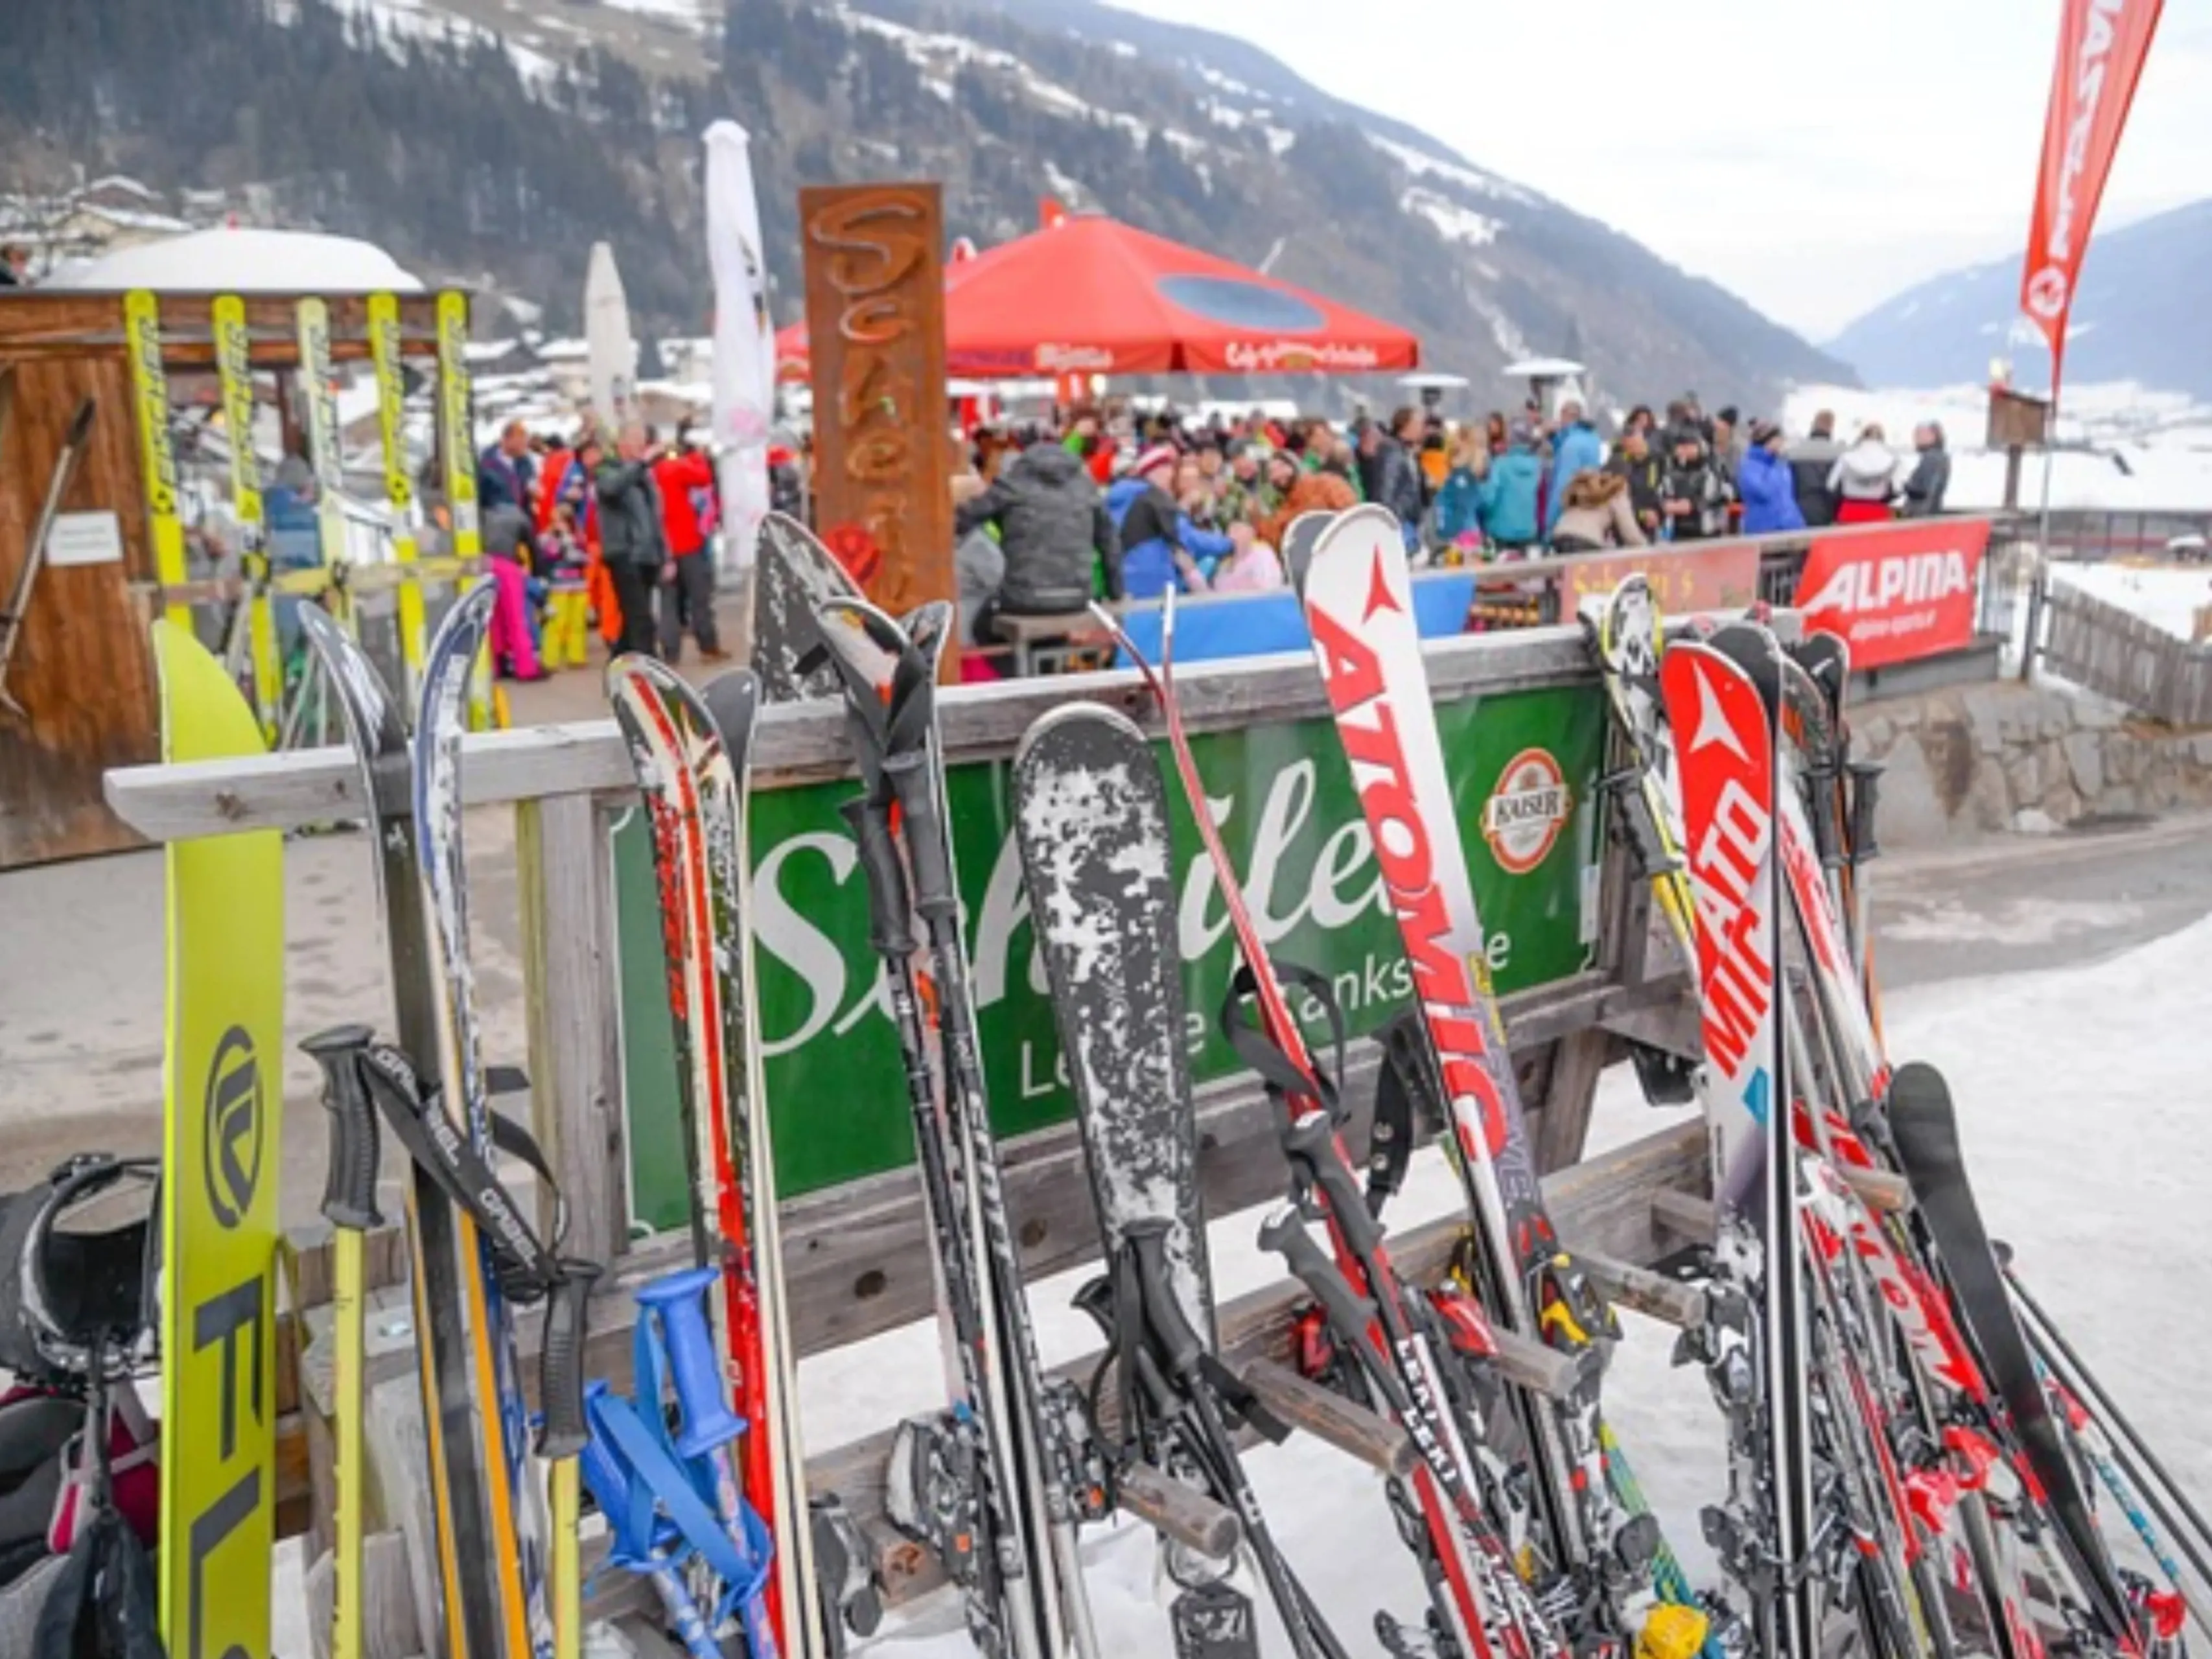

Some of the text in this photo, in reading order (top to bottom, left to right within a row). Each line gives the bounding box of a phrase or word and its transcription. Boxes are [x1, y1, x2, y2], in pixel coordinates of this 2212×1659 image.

[1800, 551, 1968, 614] ALPINA
[1495, 790, 1559, 826] KAISER
[1295, 601, 1507, 1160] ATOMIC
[1404, 1406, 1458, 1483] LEKI
